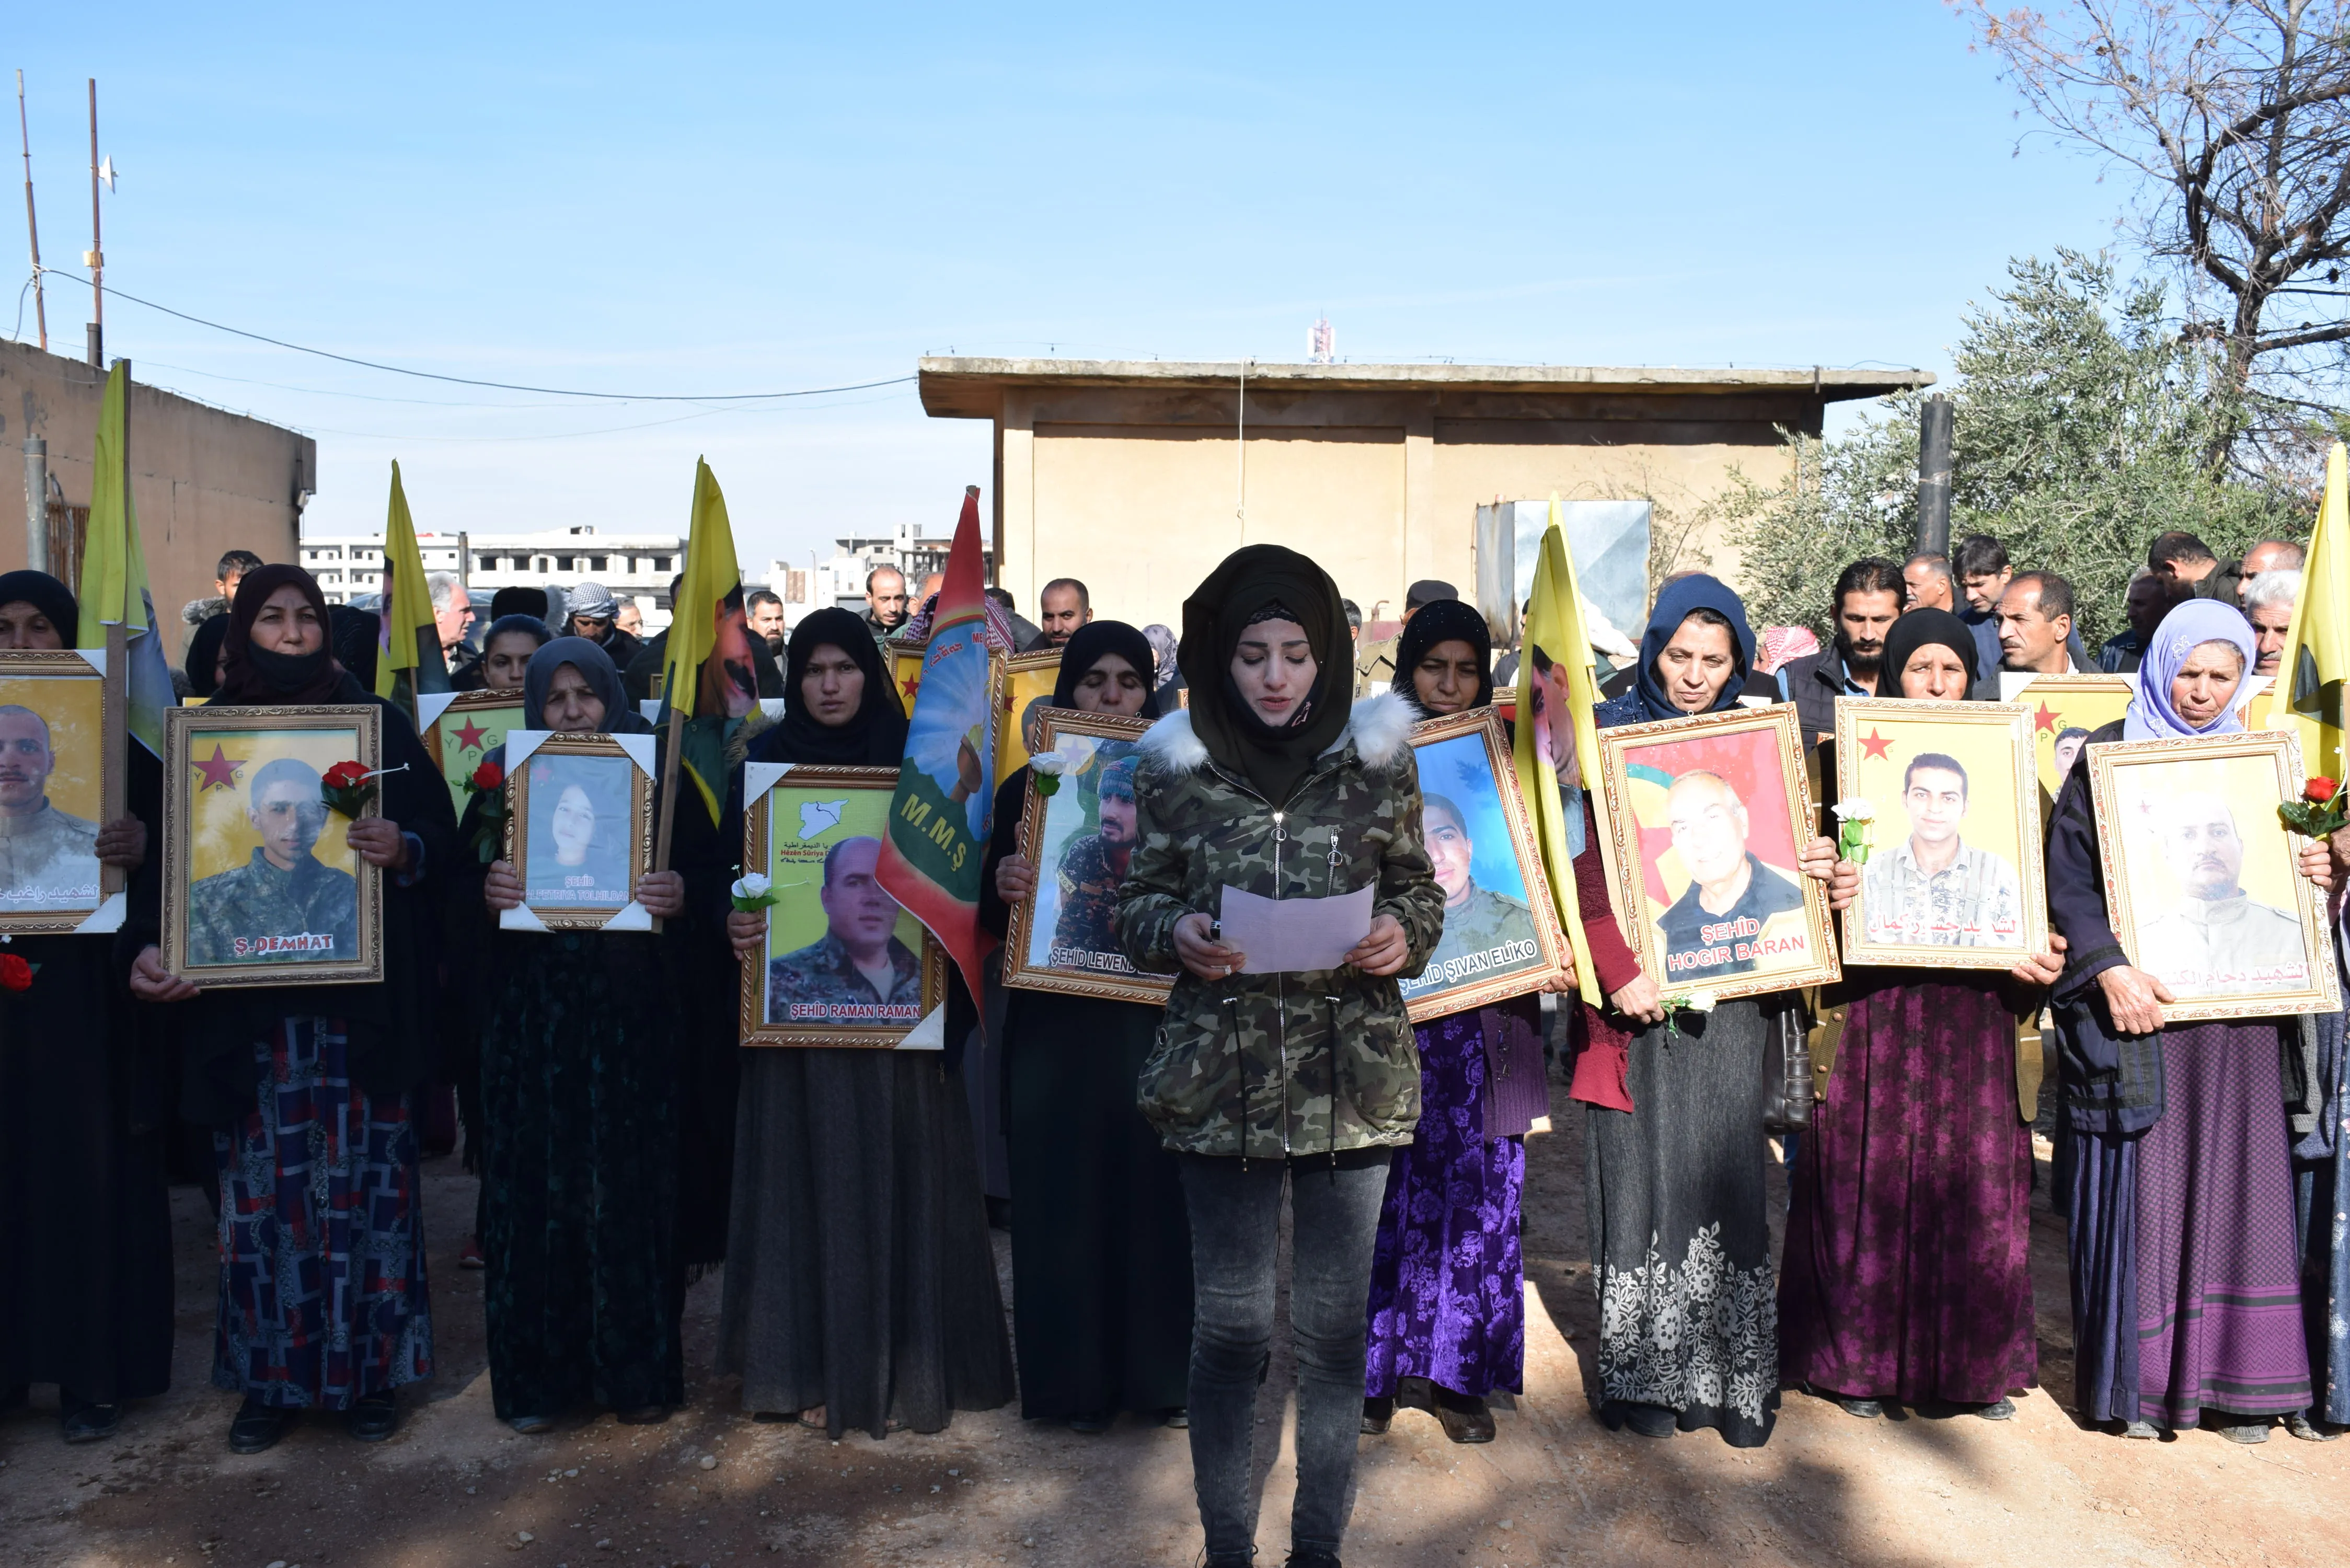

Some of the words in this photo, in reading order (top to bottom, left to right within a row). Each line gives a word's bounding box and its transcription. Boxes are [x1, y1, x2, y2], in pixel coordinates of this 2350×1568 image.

[901, 793, 966, 872] M.M.Ş
[566, 874, 594, 887] ŞEHÎD
[48, 884, 99, 903] لشهيد
[1702, 917, 1759, 944] ŞEHÎD
[235, 935, 332, 955] Ş.DEMHAT
[1669, 947, 1732, 971] HOGIR
[1736, 936, 1804, 960] BARAN
[1051, 947, 1087, 966] ŞEHÎD
[1444, 952, 1489, 982] ŞIVAN
[1491, 940, 1536, 966] ELÎKO
[791, 1001, 827, 1019] ŞEHÎD
[831, 1005, 874, 1018] RAMAN
[878, 1005, 921, 1018] RAMAN
